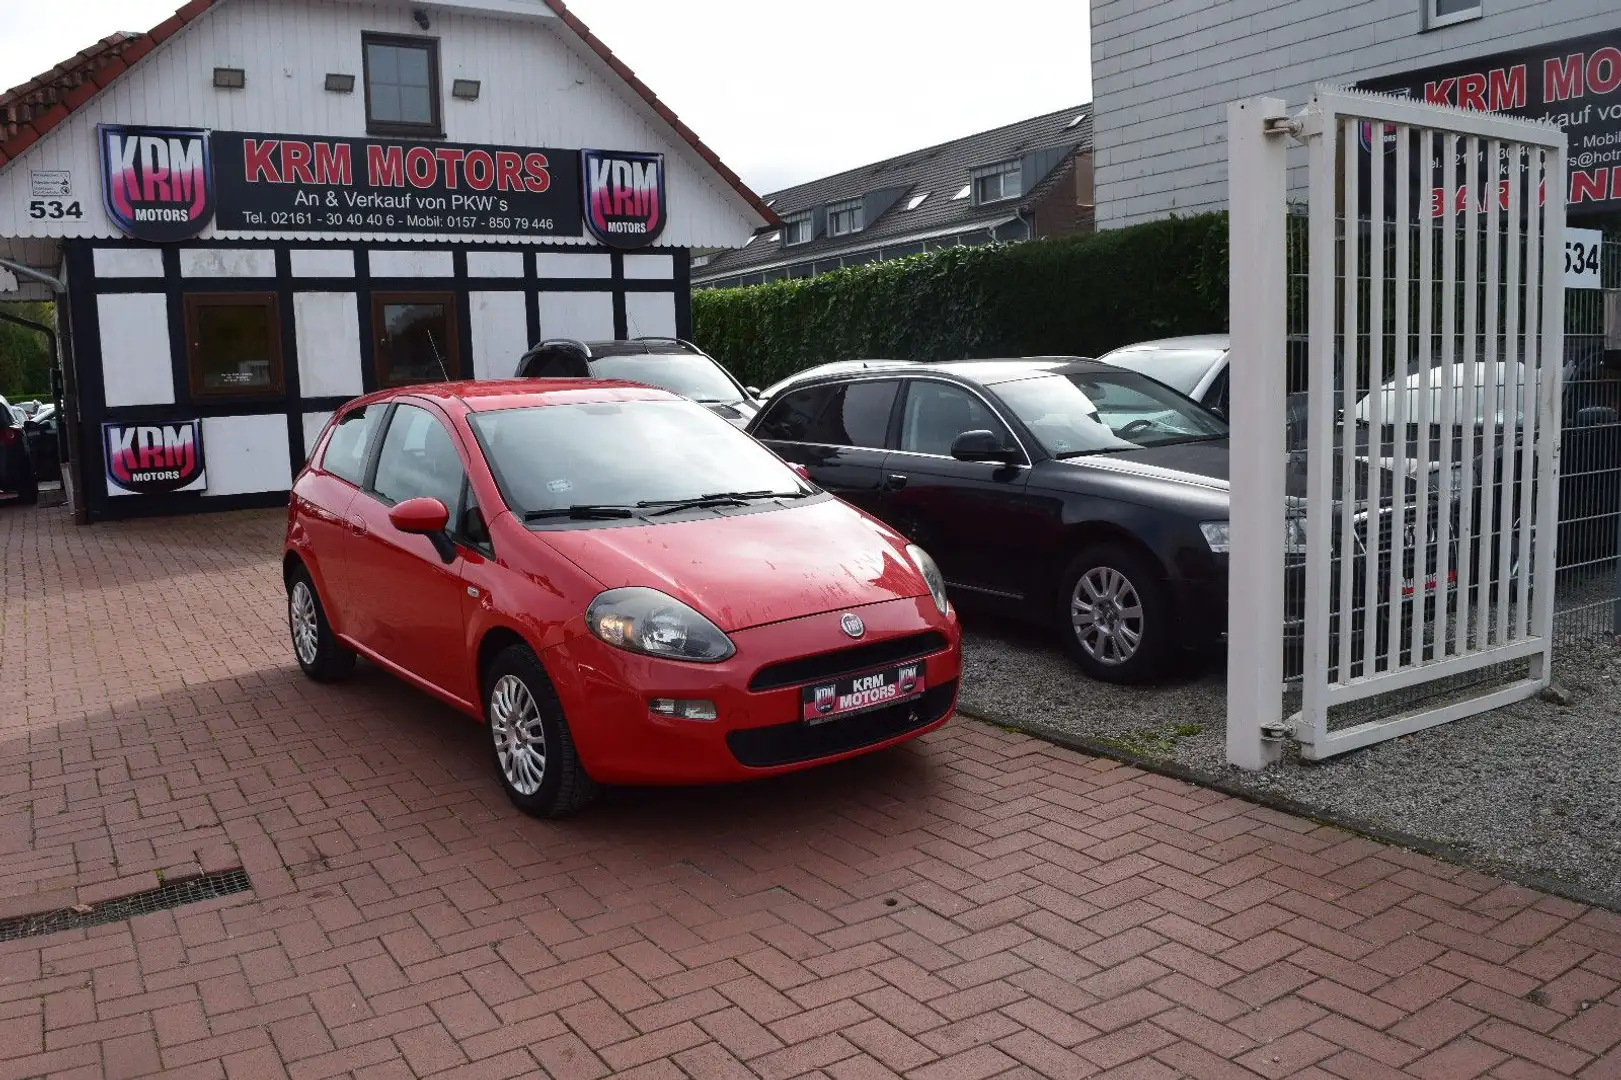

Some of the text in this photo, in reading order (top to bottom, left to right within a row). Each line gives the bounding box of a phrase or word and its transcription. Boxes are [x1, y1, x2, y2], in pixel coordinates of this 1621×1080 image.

[1424, 64, 1526, 112] KRM
[243, 138, 550, 194] KRM MOTORS
[110, 134, 205, 220] KRM
[294, 189, 319, 206] An
[325, 190, 339, 207] &
[343, 190, 412, 209] Verkauf
[416, 196, 446, 210] von
[590, 158, 659, 232] KRM
[30, 200, 83, 219] 534
[135, 208, 189, 222] MOTORS
[243, 211, 267, 224] Tel.
[271, 212, 312, 225] 02161
[326, 213, 343, 226] 30
[346, 213, 363, 226] 40
[366, 214, 383, 226] 40
[386, 214, 395, 227] 6
[407, 215, 443, 228] Mobil:
[447, 216, 477, 228] 0157
[489, 217, 511, 229] 850
[514, 217, 529, 230] 79
[532, 218, 554, 230] 446
[607, 221, 647, 233] MOTORS
[110, 424, 195, 481] KRM
[132, 470, 180, 482] MOTORS
[852, 673, 884, 692] KRM
[840, 683, 896, 709] MOTORS
